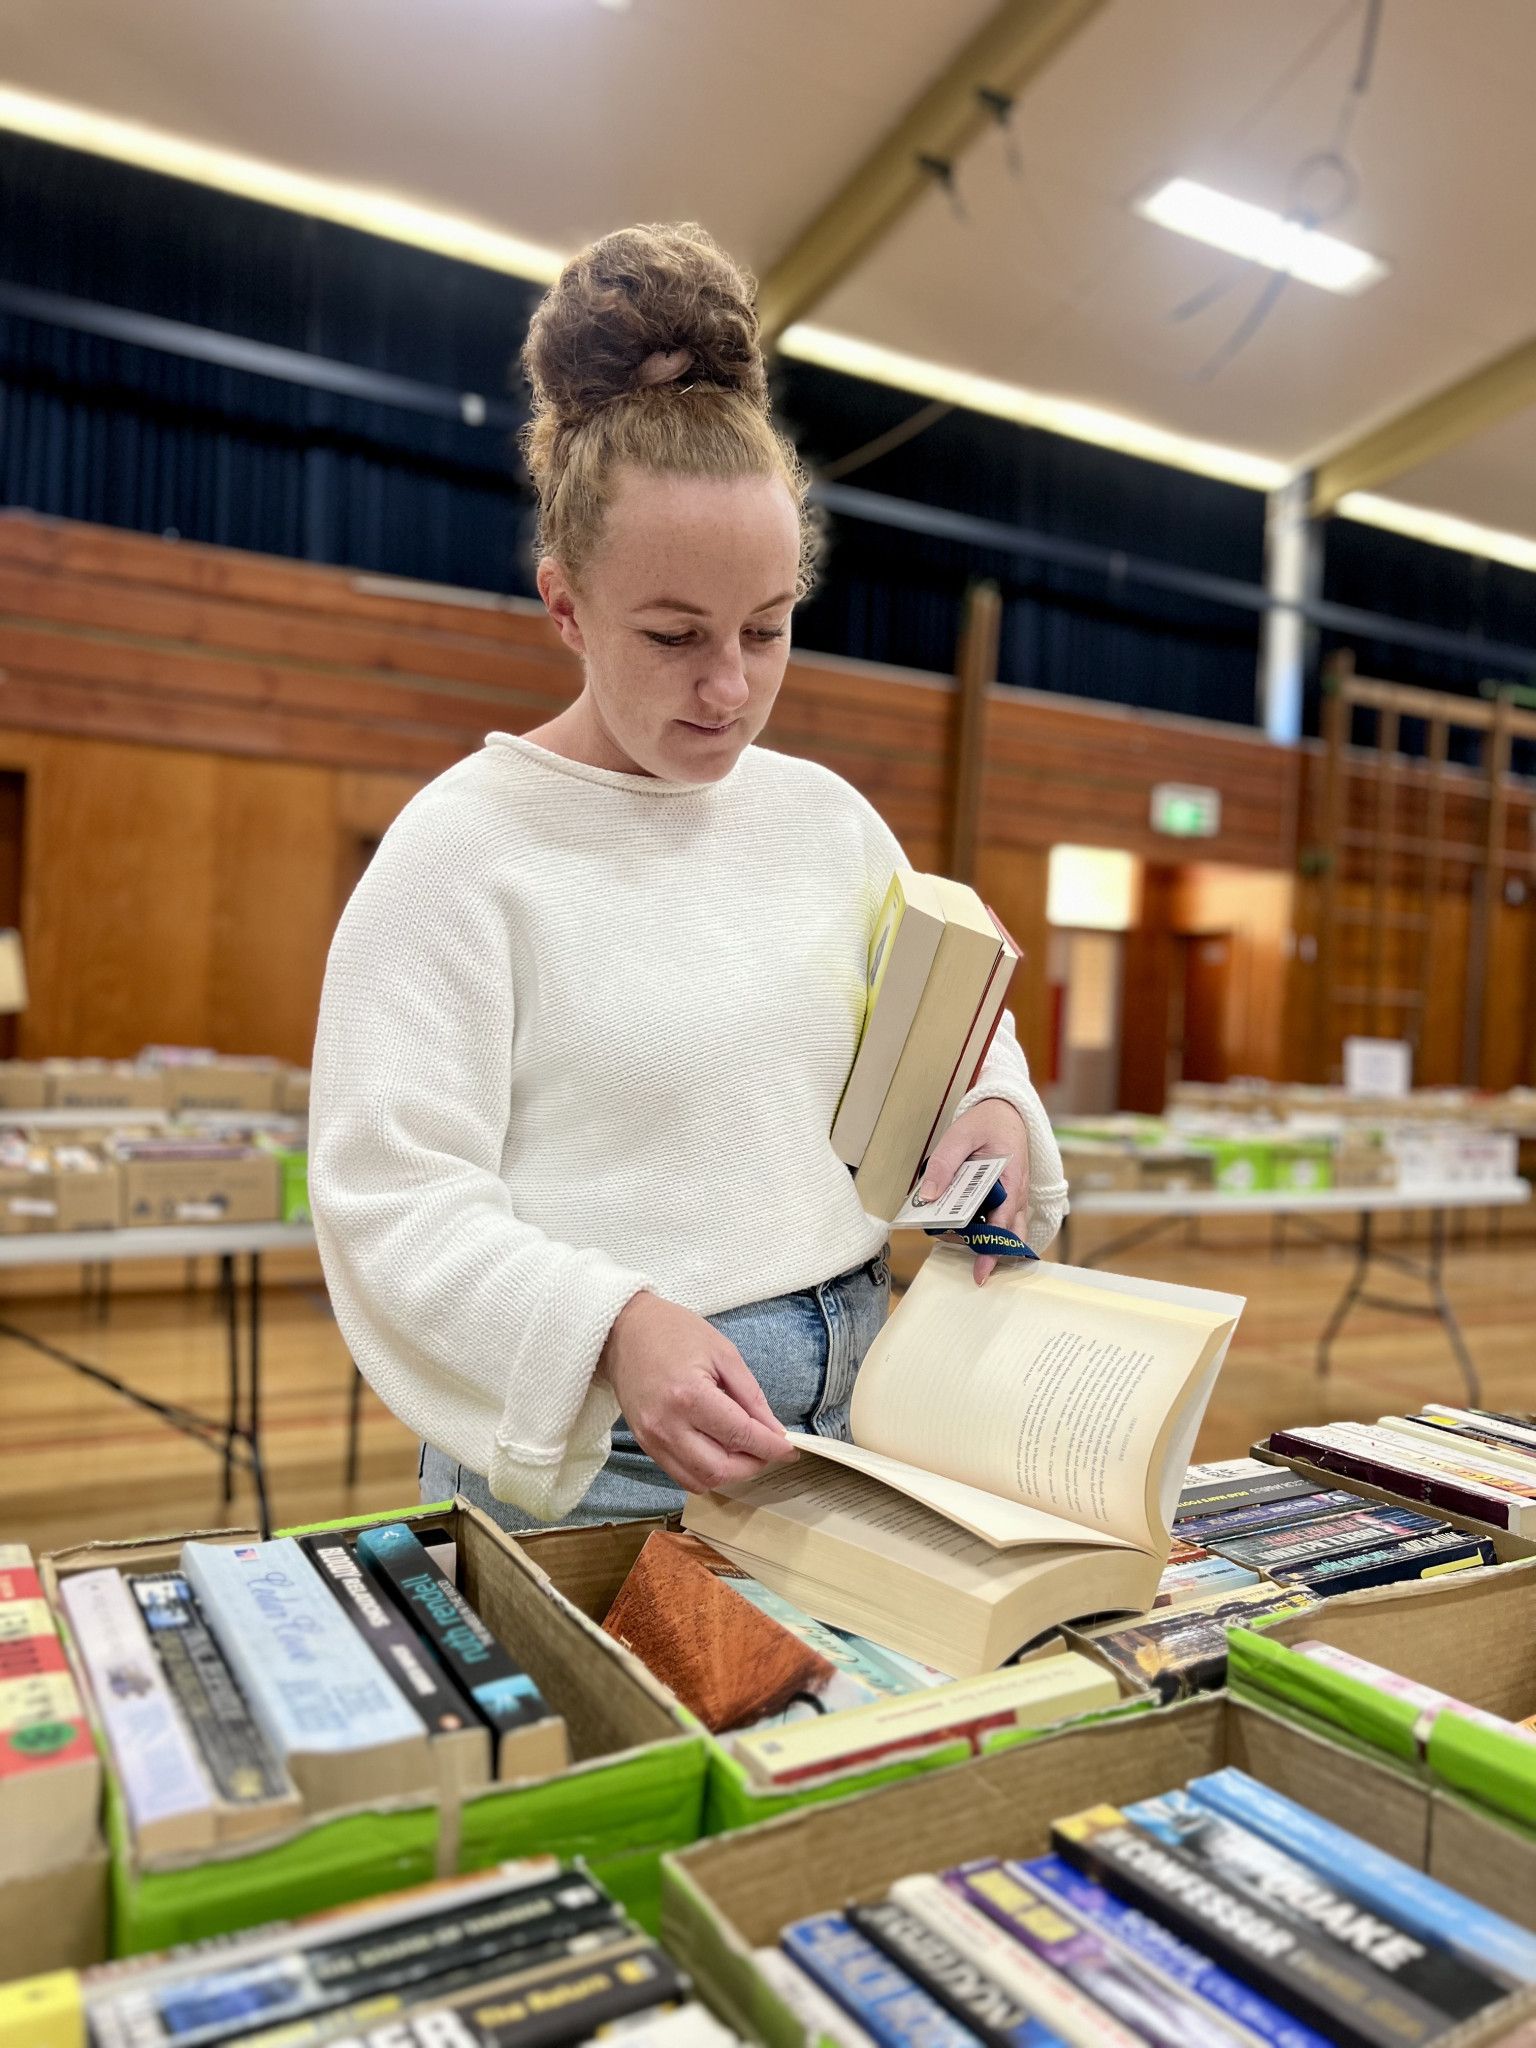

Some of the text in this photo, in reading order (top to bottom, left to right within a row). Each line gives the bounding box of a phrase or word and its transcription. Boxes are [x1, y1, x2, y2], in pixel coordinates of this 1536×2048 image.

[972, 1234, 1023, 1248] HORSHAM
[315, 1546, 392, 1628] BLOODY RELATIONS
[399, 1572, 462, 1627] rendell
[439, 1623, 490, 1665] ruth
[1114, 1837, 1298, 1960] CONFESSOR
